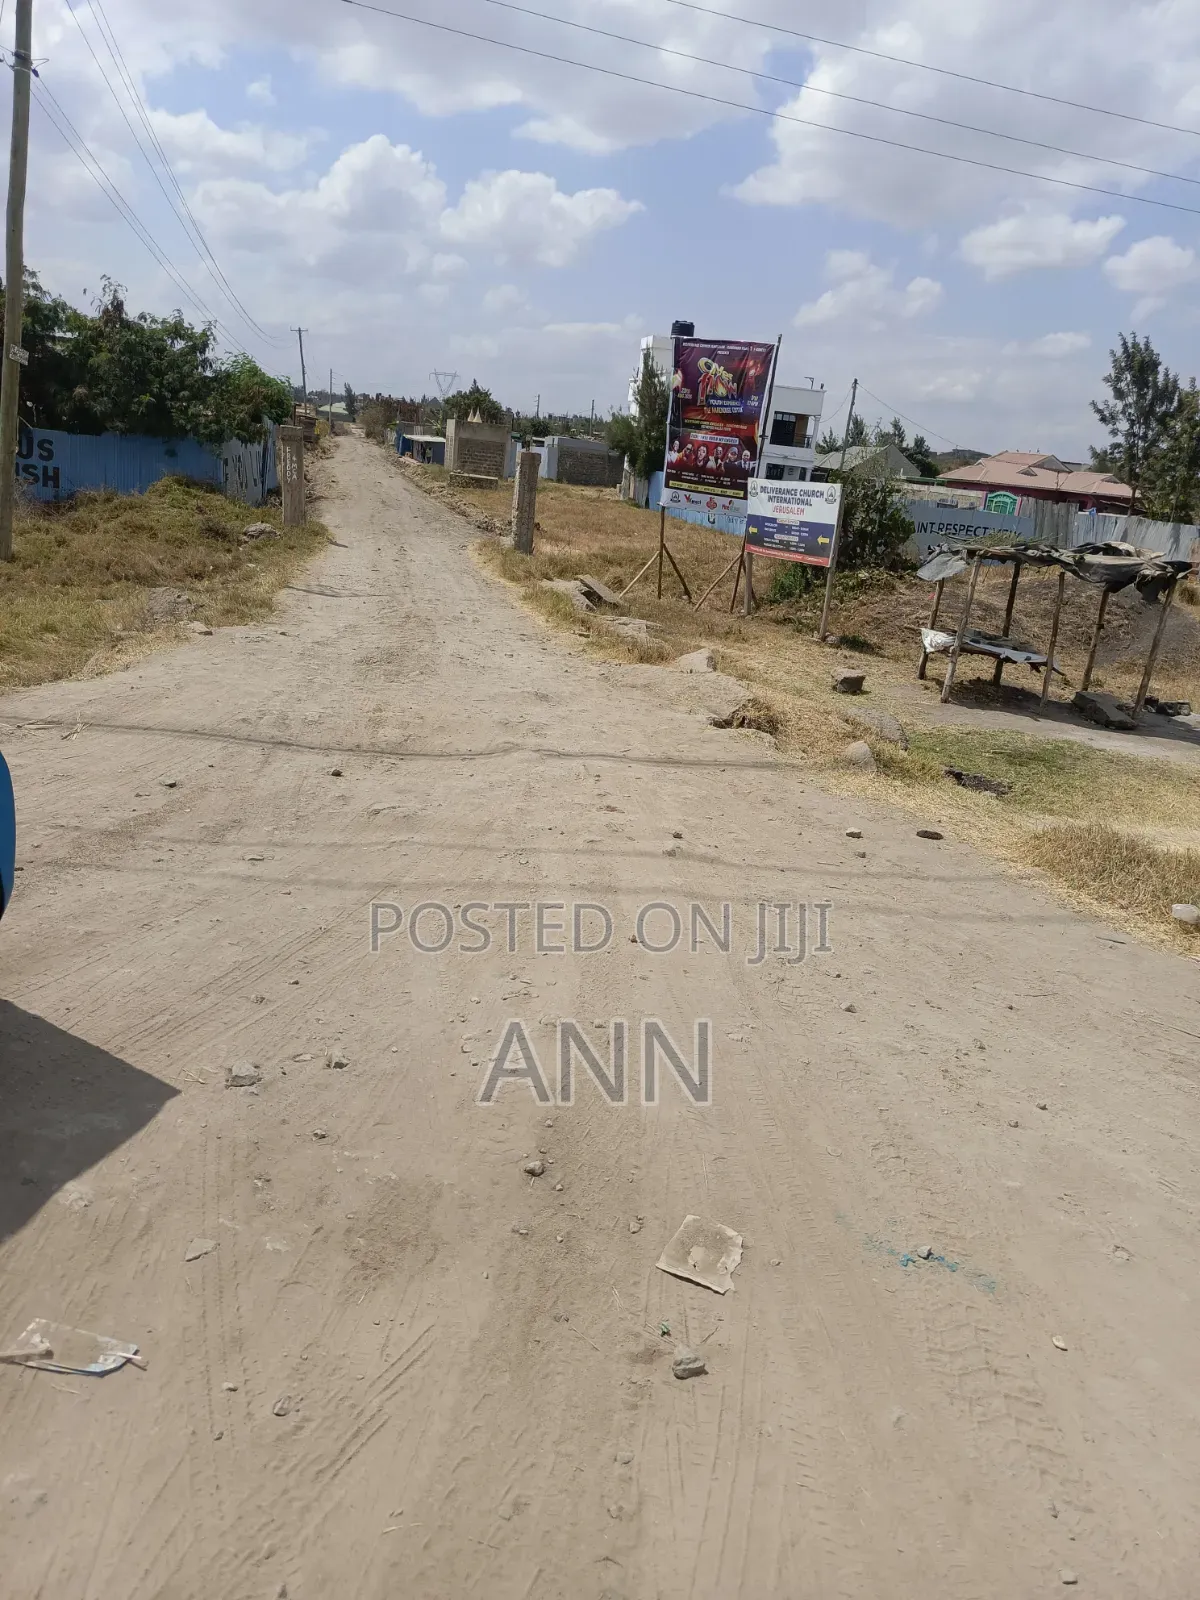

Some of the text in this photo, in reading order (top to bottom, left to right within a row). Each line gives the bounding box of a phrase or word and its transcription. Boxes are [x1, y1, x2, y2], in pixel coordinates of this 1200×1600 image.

[760, 485, 825, 499] DELIVERANCE CHURCH
[767, 495, 813, 507] INTERNATIONAL
[772, 505, 805, 516] JERUSALEM
[937, 522, 990, 537] RESPECT
